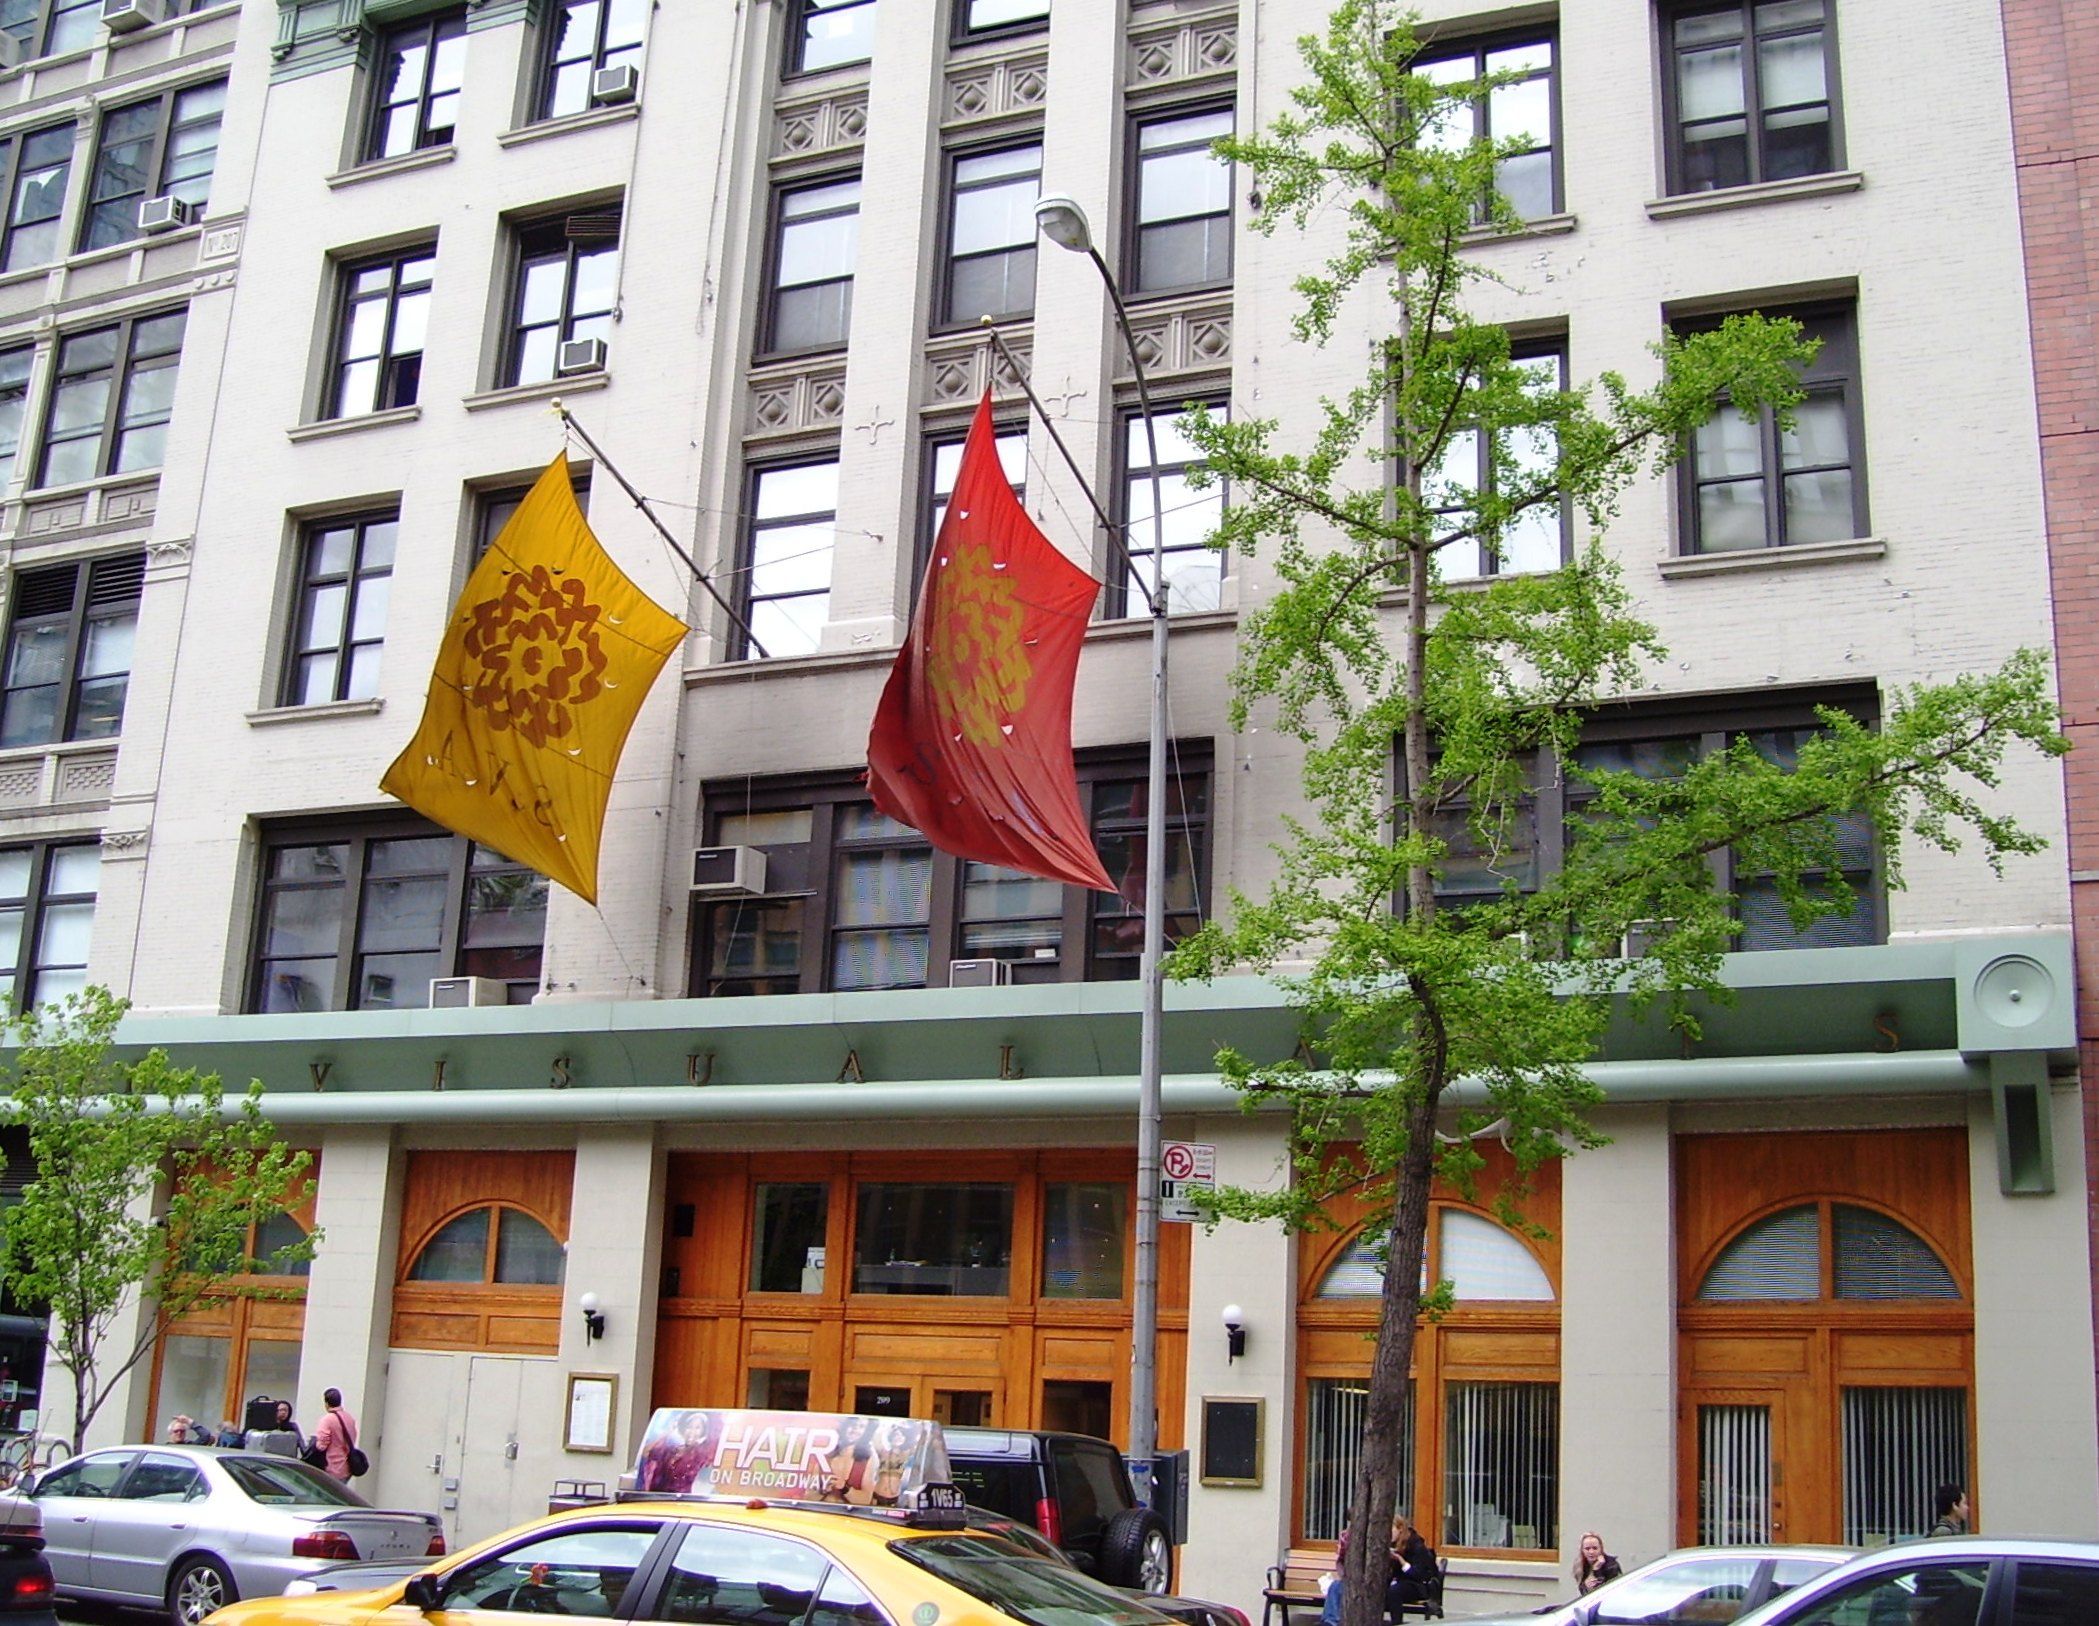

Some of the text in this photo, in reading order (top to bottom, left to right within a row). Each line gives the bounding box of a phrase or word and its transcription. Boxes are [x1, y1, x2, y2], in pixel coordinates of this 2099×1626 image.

[309, 1044, 1025, 1093] VISUAL
[713, 1425, 839, 1473] HAIR
[709, 1468, 832, 1491] ON BROADWAY
[931, 1487, 954, 1508] 1V65
